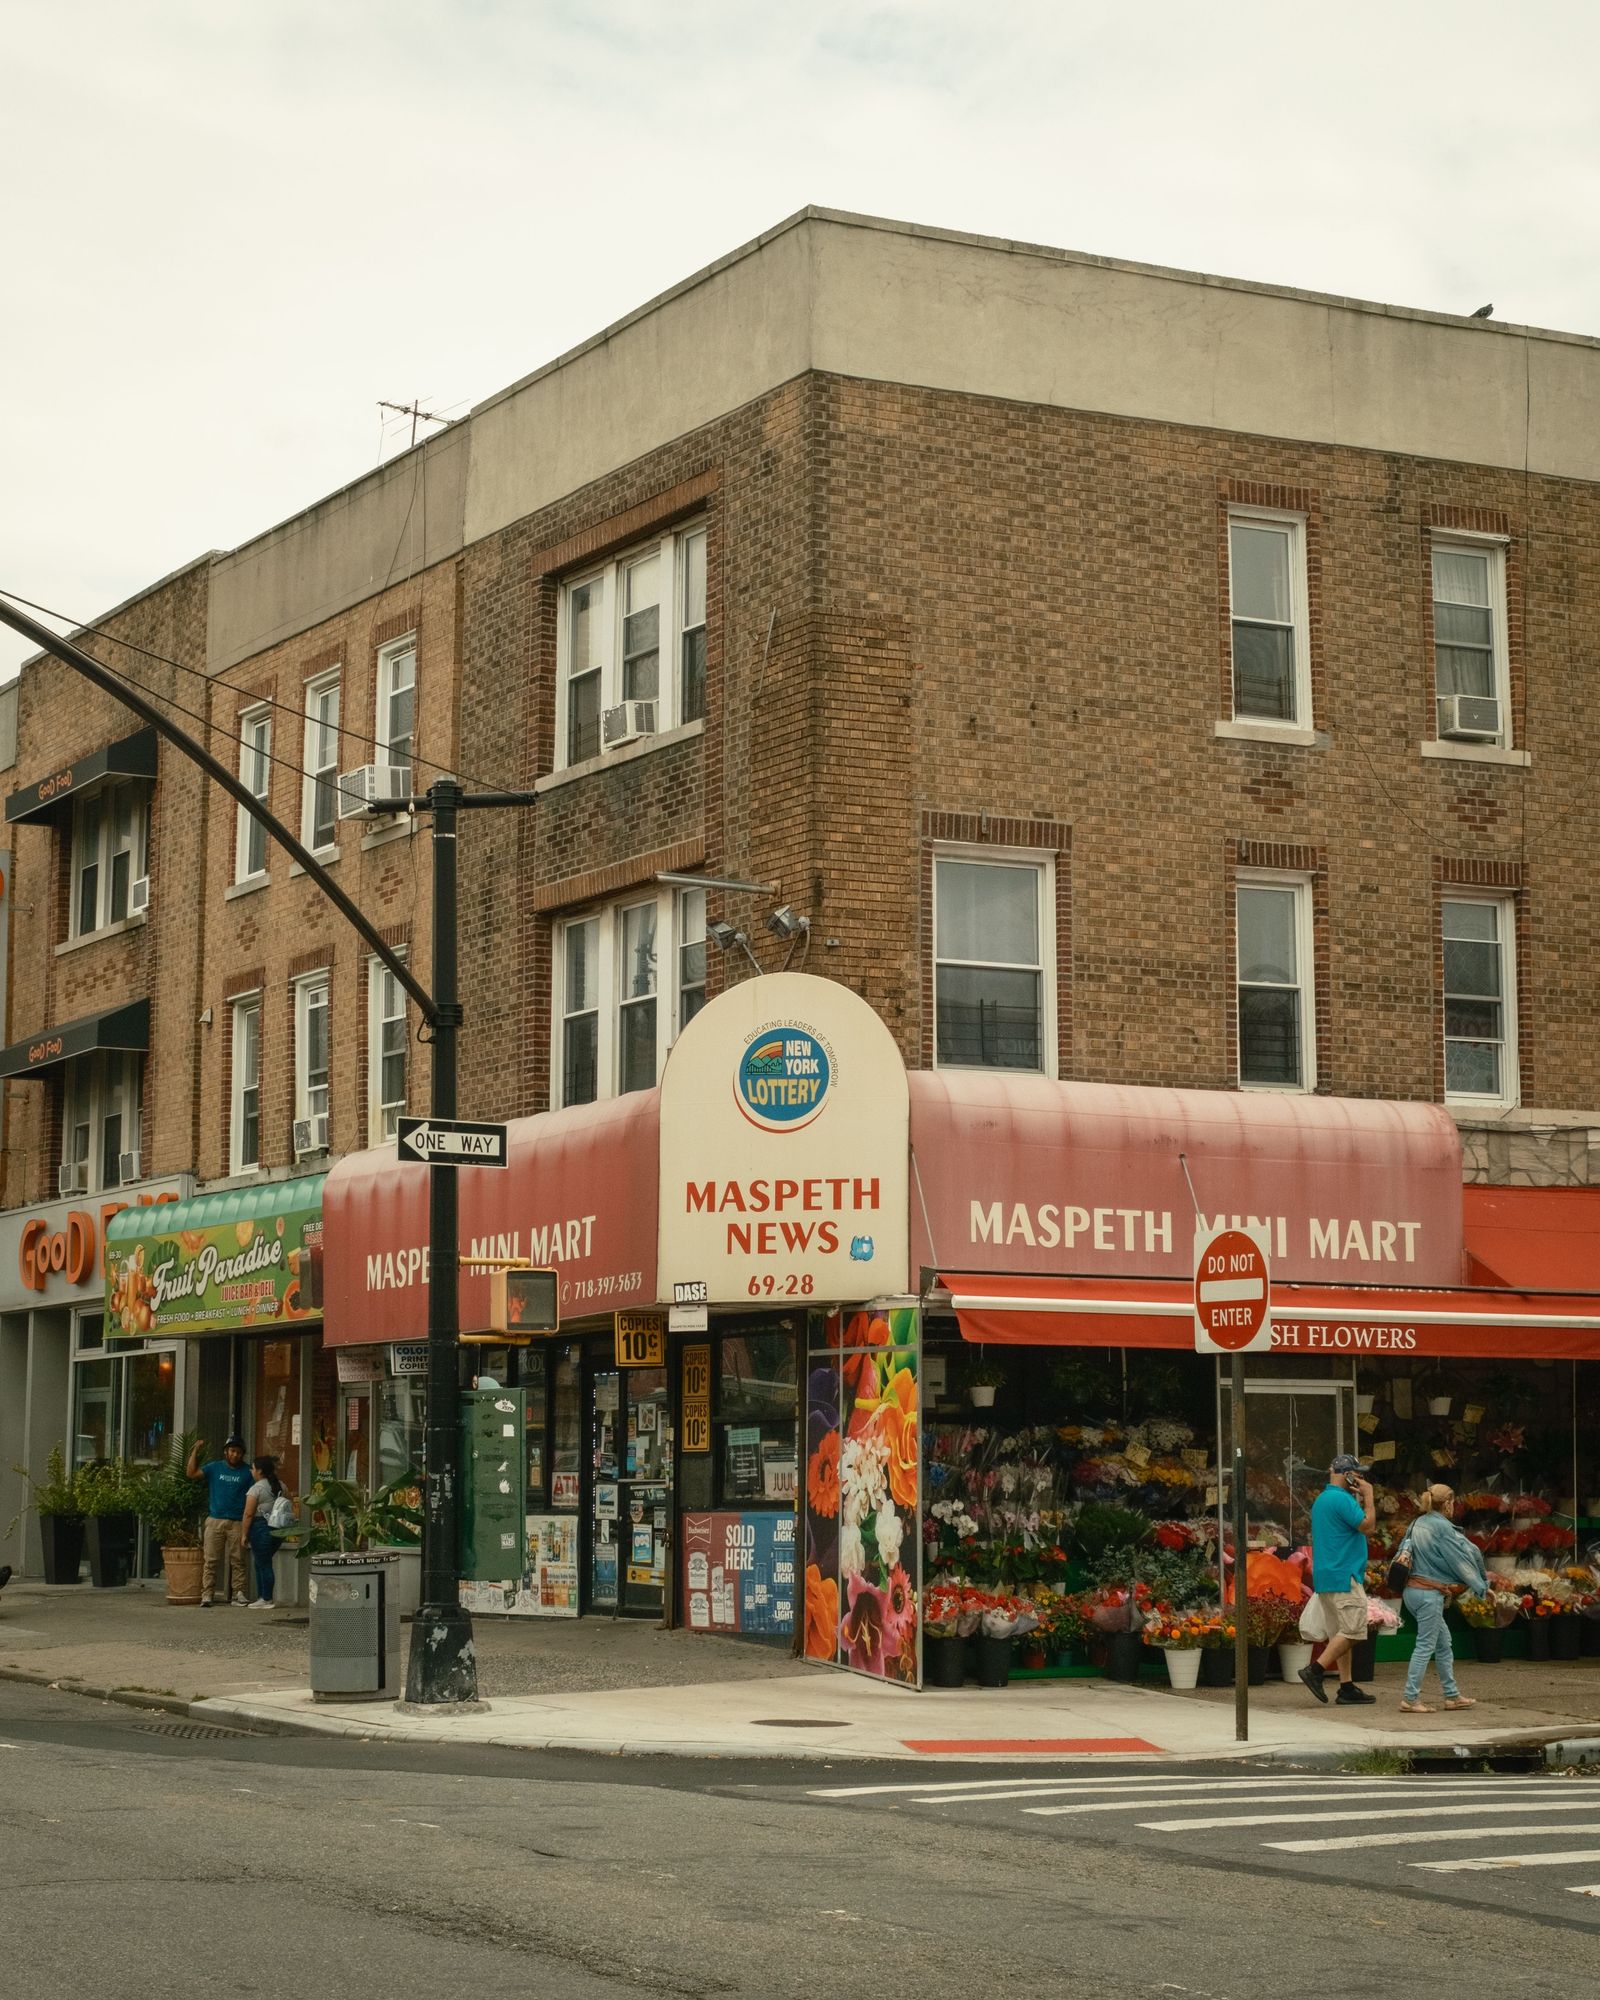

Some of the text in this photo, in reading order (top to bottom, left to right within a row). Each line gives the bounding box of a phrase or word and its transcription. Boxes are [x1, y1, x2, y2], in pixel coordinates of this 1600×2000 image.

[743, 1019, 839, 1088] EDUCATING LEADERS OF TOMORROW
[785, 1040, 811, 1057] NEW
[785, 1058, 819, 1075] YORK
[747, 1079, 821, 1105] LOTTERY
[415, 1132, 493, 1153] ONE WAY
[685, 1177, 880, 1213] MASPETH
[726, 1220, 840, 1255] NEWS
[970, 1200, 1173, 1253] MASPETH
[1309, 1218, 1422, 1262] MART
[367, 1246, 430, 1291] MASPE
[530, 1215, 596, 1267] MART
[1208, 1253, 1255, 1274] DO NOT
[150, 1257, 196, 1311] Fruit
[195, 1235, 282, 1296] Paradise
[221, 1284, 239, 1302] JUICE
[240, 1283, 253, 1300] BAR
[260, 1280, 275, 1297] DELI
[575, 1272, 642, 1300] 718-397-5633
[675, 1283, 707, 1302] DASE
[748, 1273, 814, 1296] 69-28
[157, 1301, 279, 1324] FRESH FOOD BREAKFAST LUNCH DINNER
[1211, 1307, 1253, 1327] ENTER
[620, 1317, 659, 1331] COPIES
[1307, 1326, 1417, 1349] FLOWERS
[685, 1352, 707, 1365] COPIES
[685, 1404, 707, 1418] COPIES
[725, 1525, 755, 1547] SOLD
[776, 1519, 794, 1531] BUD
[725, 1548, 755, 1570] HERE
[776, 1562, 793, 1573] BUD
[774, 1610, 794, 1620] LIGHT
[776, 1601, 791, 1611] BUD
